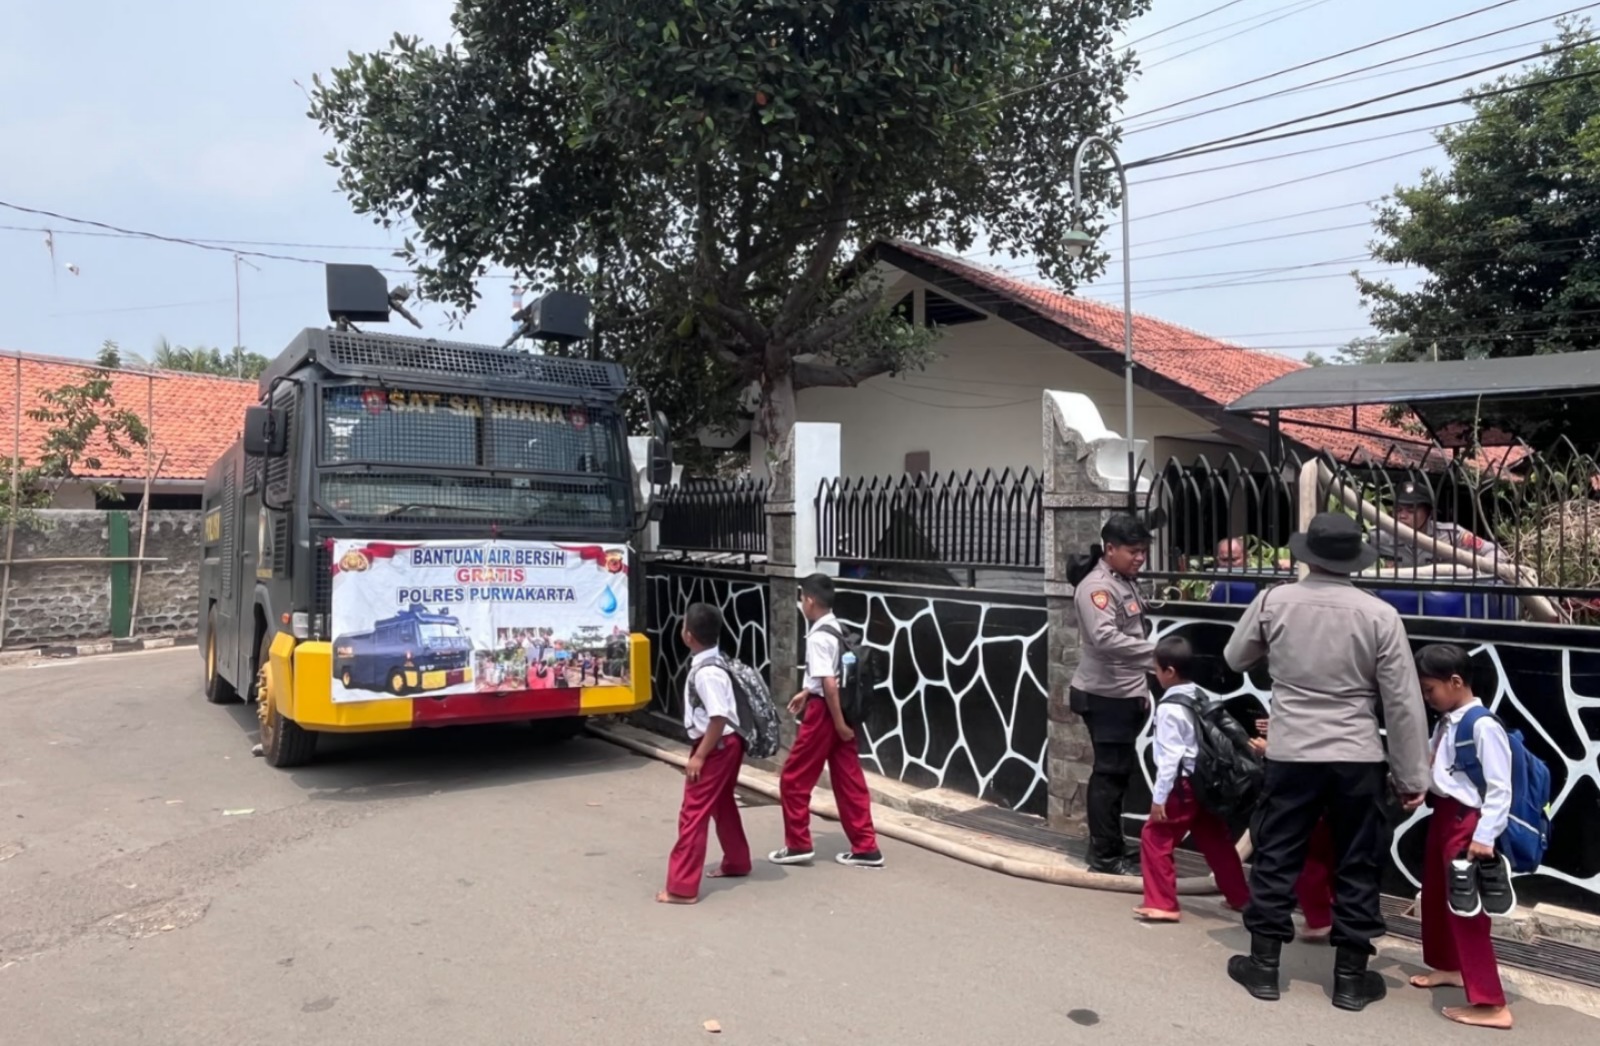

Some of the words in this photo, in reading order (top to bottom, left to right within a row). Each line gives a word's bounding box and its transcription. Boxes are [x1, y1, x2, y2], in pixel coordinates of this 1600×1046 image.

[388, 390, 440, 413] SAT
[413, 549, 483, 565] BANTUAN
[488, 550, 511, 564] AIR
[515, 550, 565, 565] BERSIH
[457, 568, 525, 583] GRATIS
[400, 588, 465, 603] POLRES
[469, 587, 575, 601] PURWAKARTA
